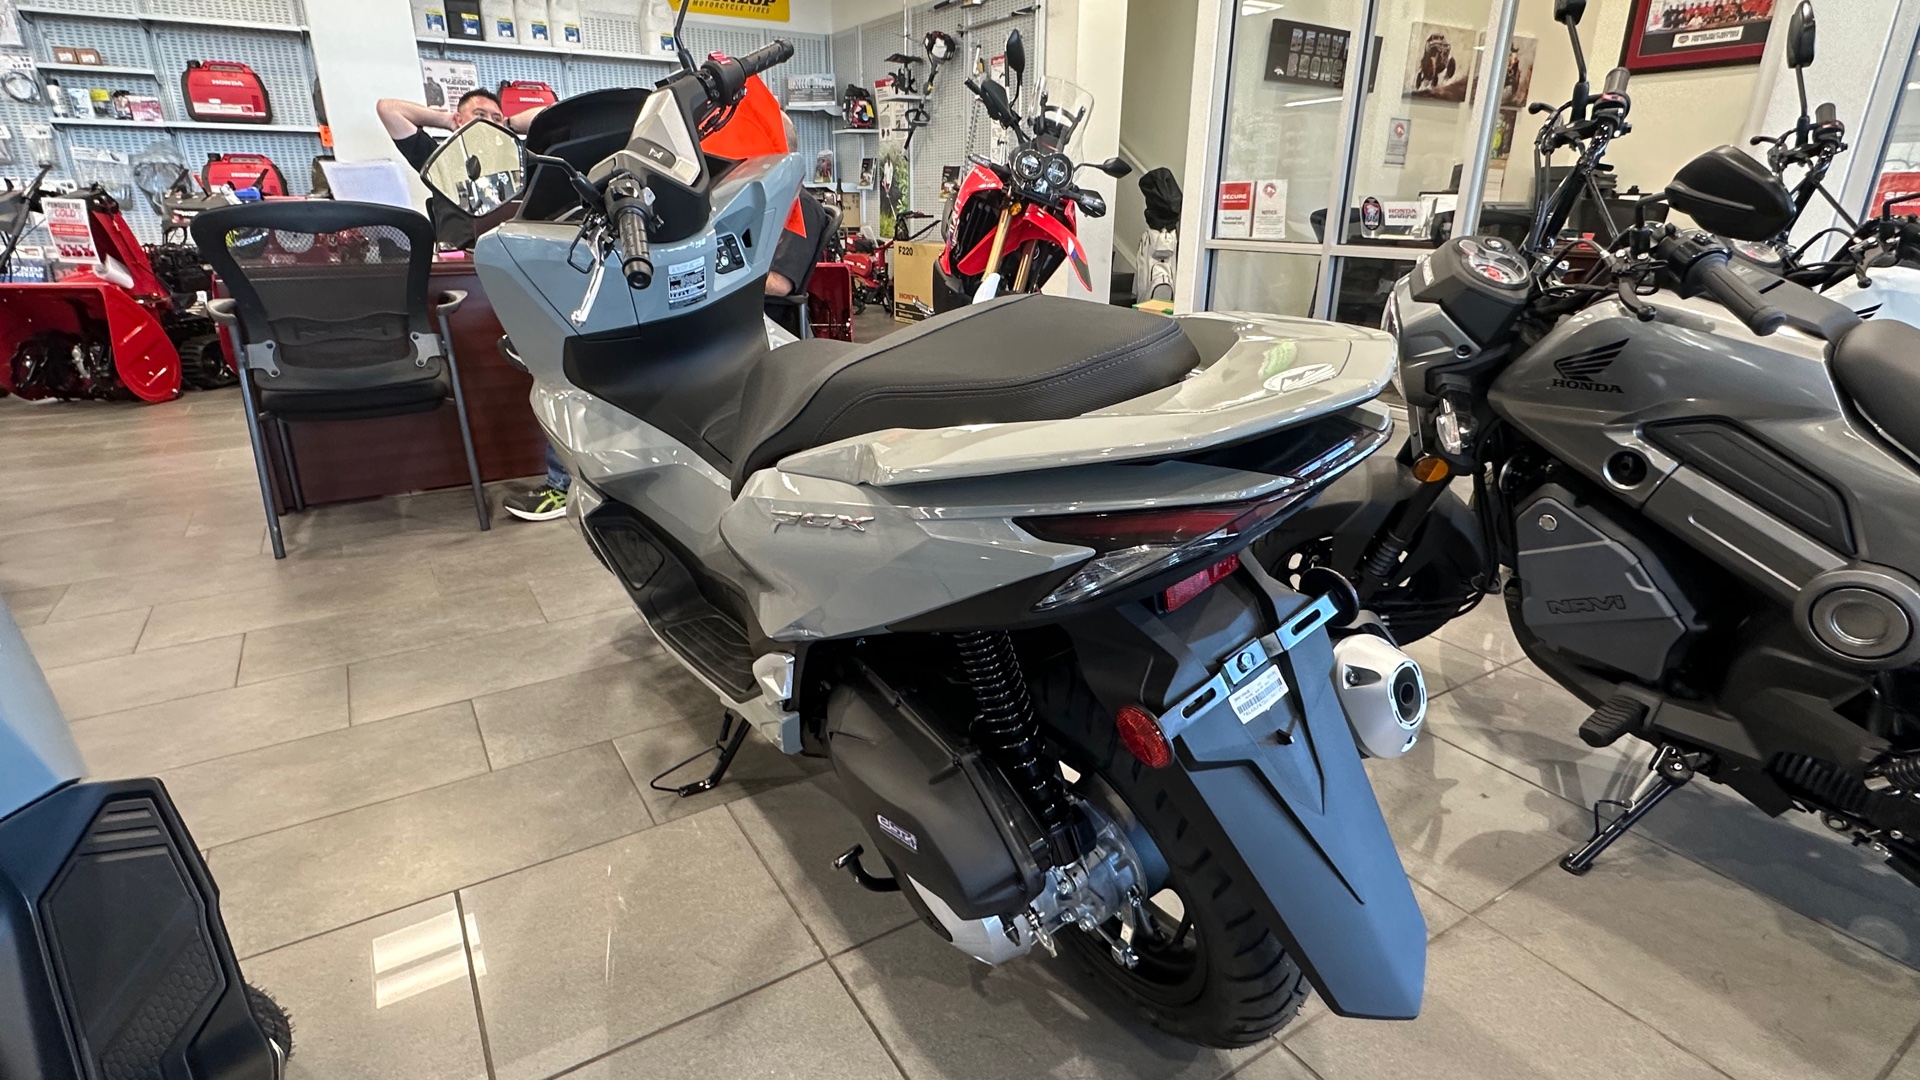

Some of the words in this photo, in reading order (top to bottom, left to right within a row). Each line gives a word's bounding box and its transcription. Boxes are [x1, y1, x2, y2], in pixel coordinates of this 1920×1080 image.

[691, 0, 744, 11] MOTORCYCLE
[748, 6, 771, 15] TIRES
[1290, 28, 1350, 59] DENV
[211, 79, 245, 87] HONDA
[54, 209, 77, 218] COLD
[898, 245, 914, 256] F220
[1552, 378, 1625, 394] HONDA
[771, 510, 875, 534] PCX
